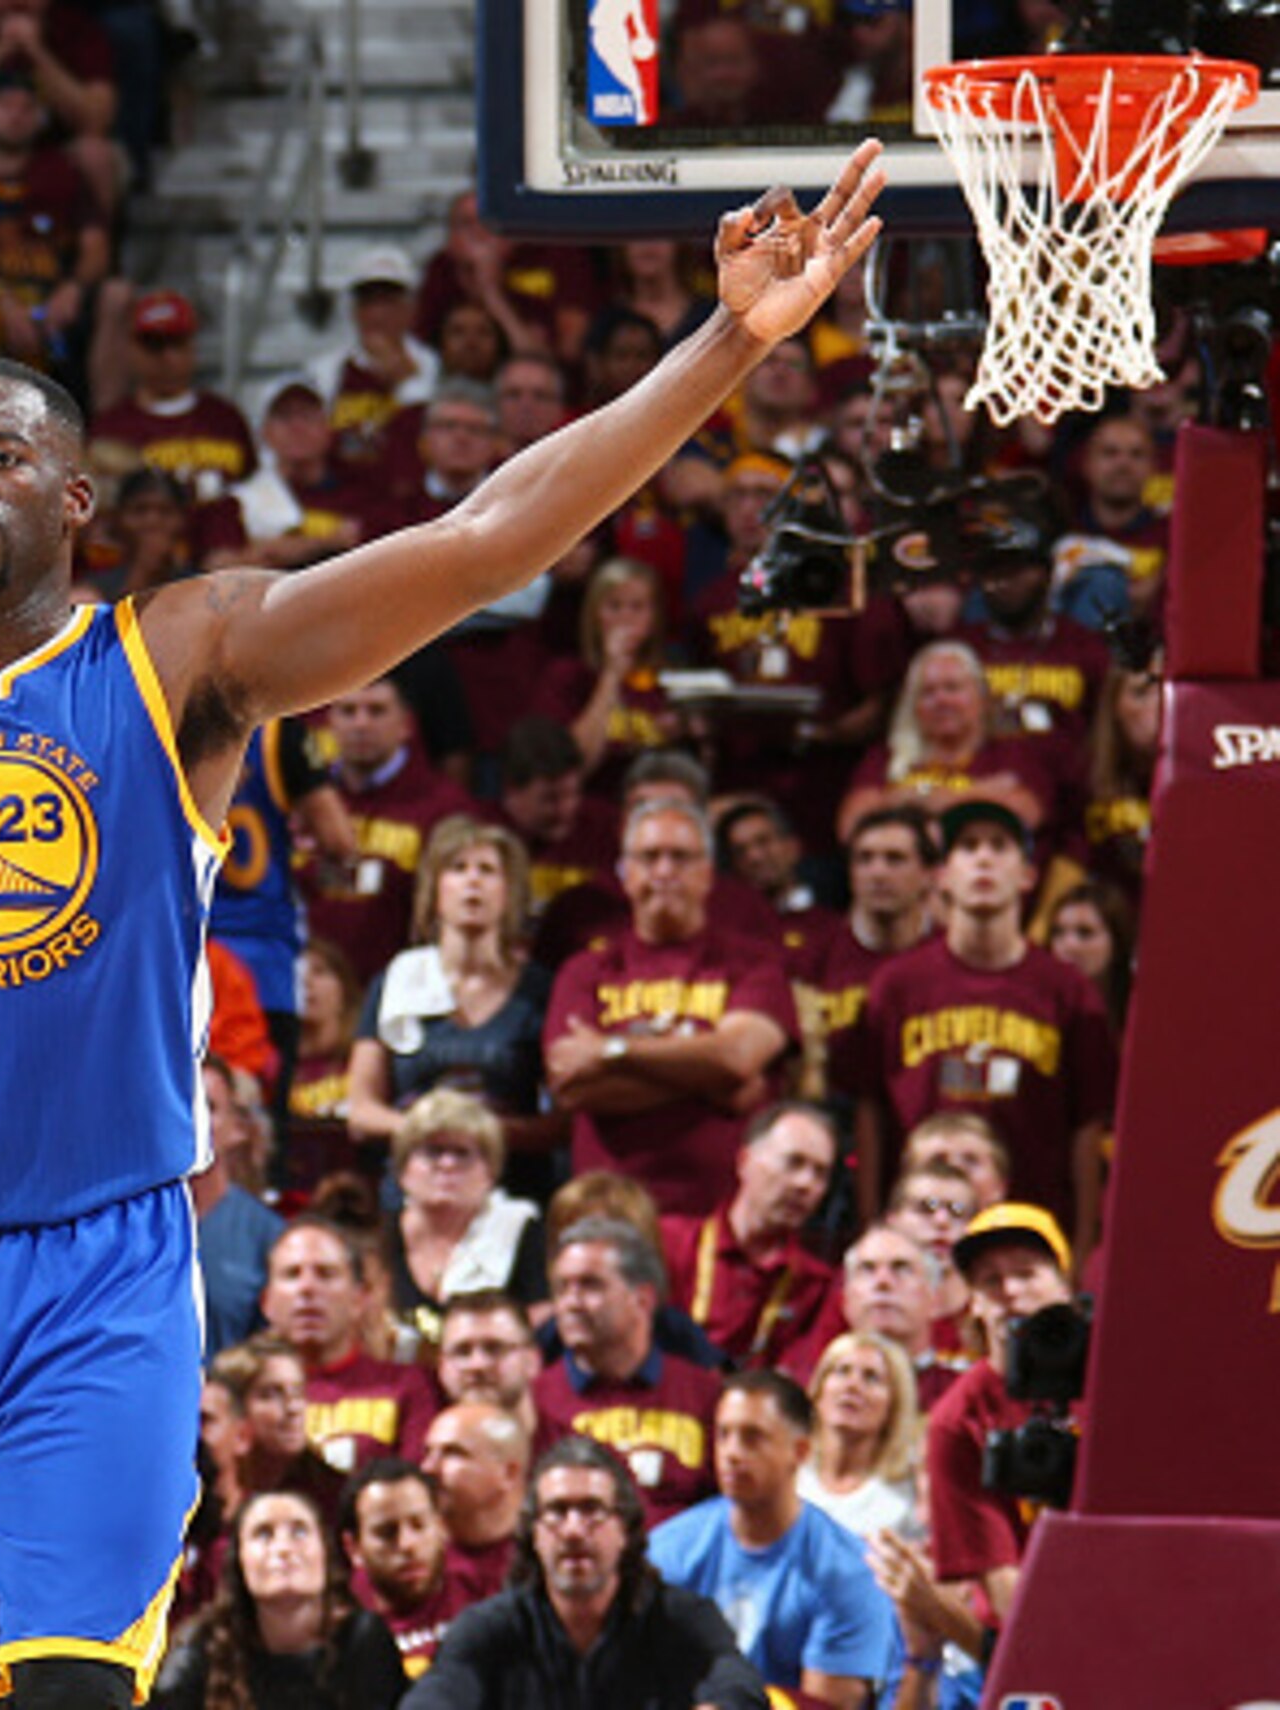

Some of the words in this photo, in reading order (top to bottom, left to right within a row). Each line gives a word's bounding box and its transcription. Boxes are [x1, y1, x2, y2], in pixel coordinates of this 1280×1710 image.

[562, 159, 677, 186] SPALDING
[14, 733, 99, 791] STATE
[901, 1005, 1061, 1077] CLEVELAND
